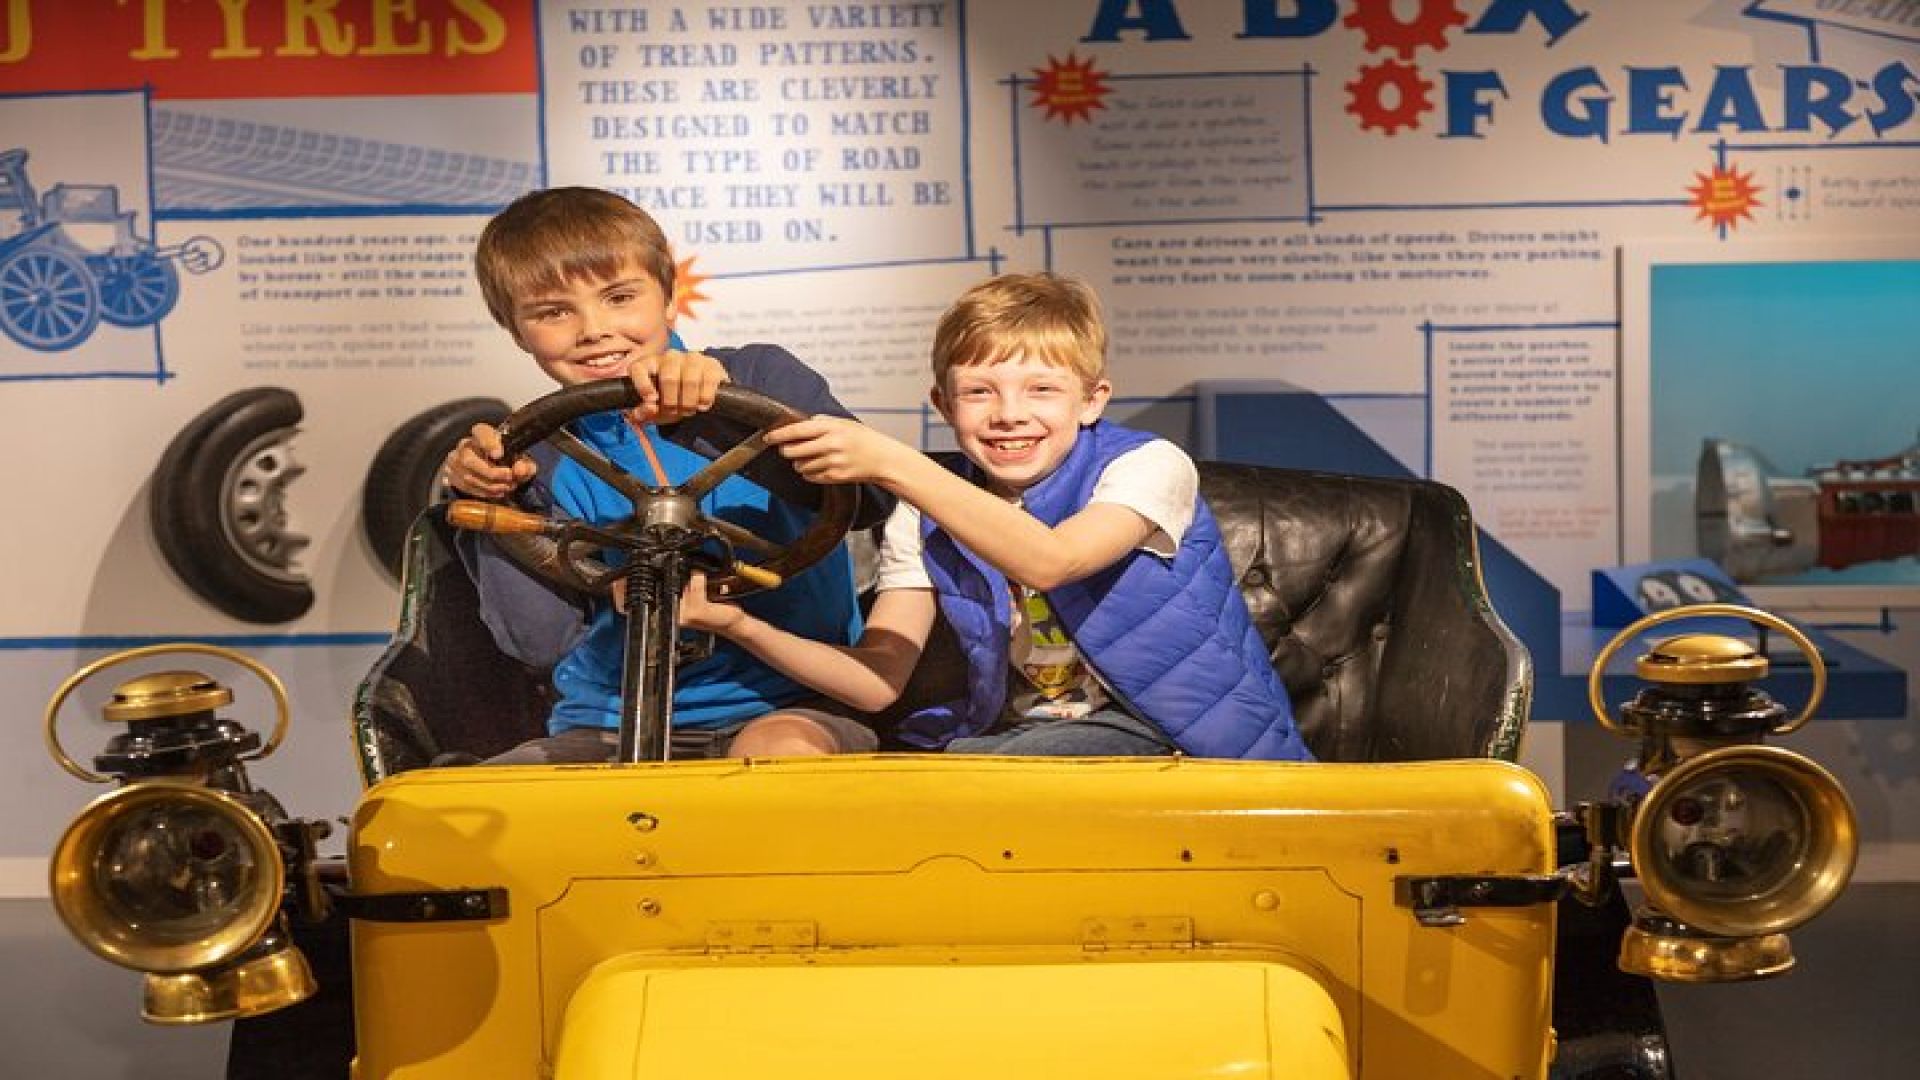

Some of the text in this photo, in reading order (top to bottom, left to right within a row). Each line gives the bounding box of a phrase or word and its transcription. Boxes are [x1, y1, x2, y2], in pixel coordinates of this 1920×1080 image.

[117, 0, 507, 59] TYRES
[568, 4, 945, 33] WITH A WIDE VARIETY
[579, 40, 935, 69] OF TREAD PATTERNS.
[578, 75, 940, 104] THESE ARE CLEVERLY
[1344, 58, 1920, 142] OF GEARS
[592, 111, 931, 140] DESIGNED TO MATCH
[601, 146, 922, 175] THE TYPE OF ROAD
[608, 181, 953, 209] FACE THEY WILL BE
[683, 218, 839, 244] USED ON.
